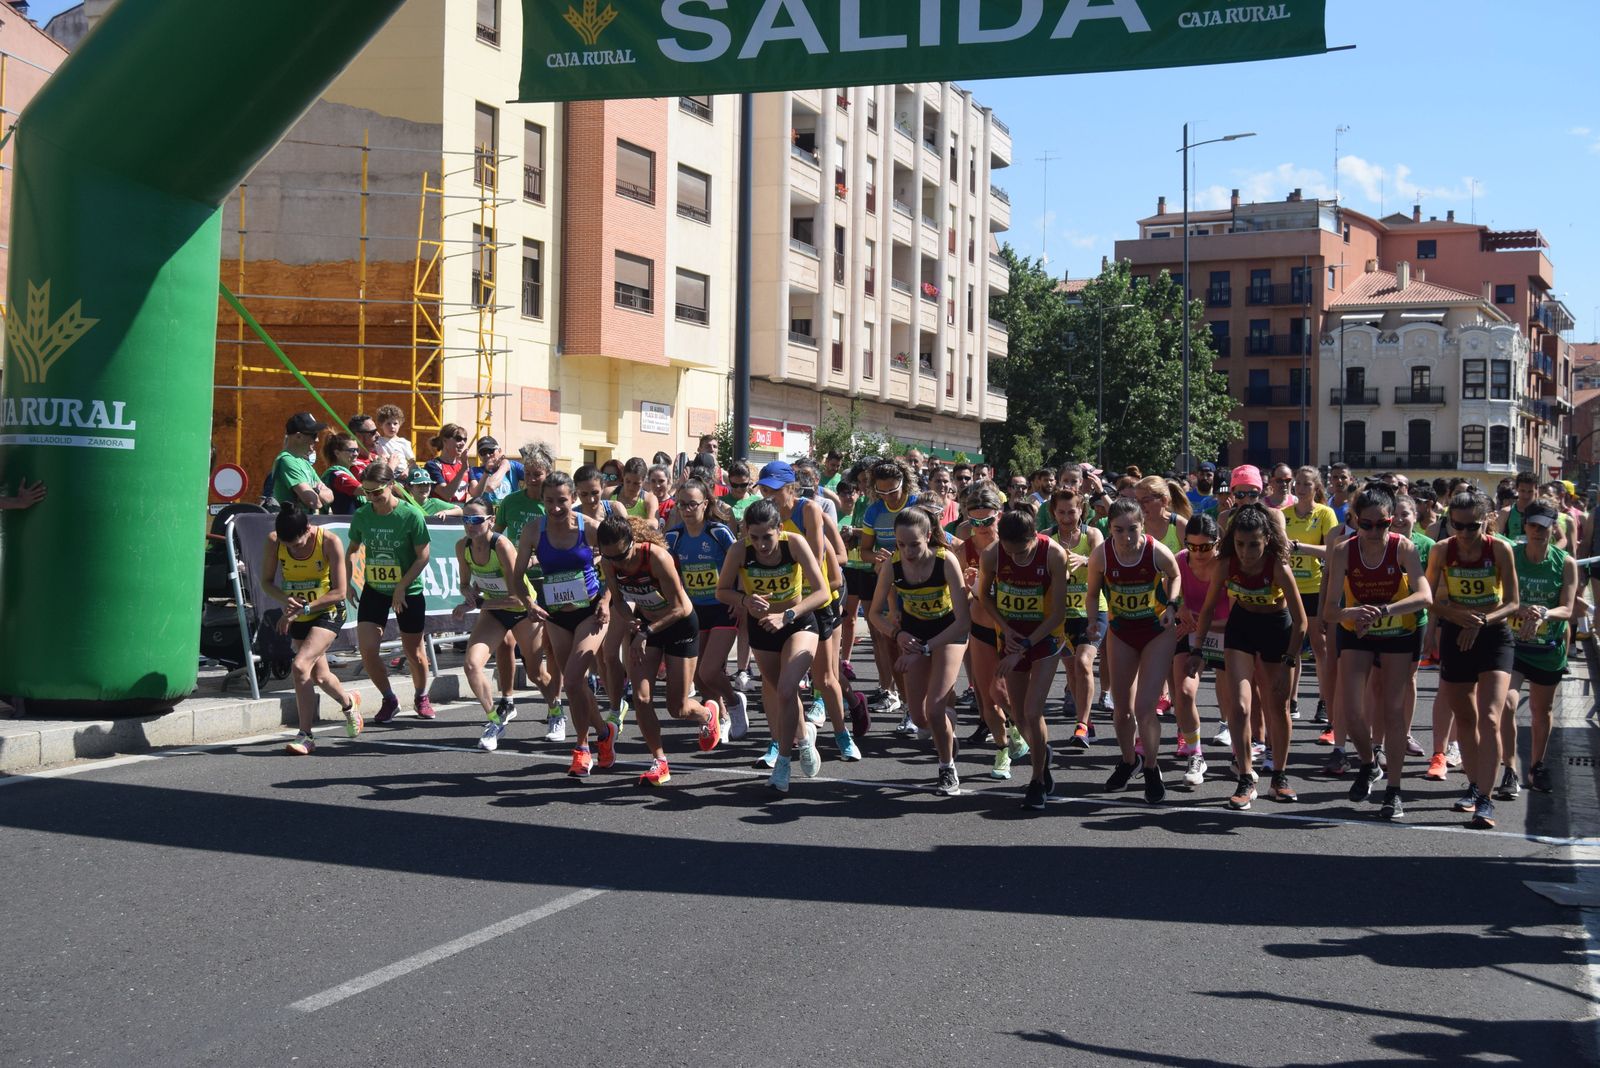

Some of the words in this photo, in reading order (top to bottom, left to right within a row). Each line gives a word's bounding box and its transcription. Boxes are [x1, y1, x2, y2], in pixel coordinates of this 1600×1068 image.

[1178, 10, 1223, 28] CAJA
[1224, 4, 1291, 24] RURAL
[656, 0, 1152, 63] SALIDA
[546, 51, 581, 68] CAJA
[581, 49, 636, 66] RURAL
[20, 397, 136, 431] RURAL
[28, 436, 73, 445] VALLADOLID
[88, 438, 124, 447] ZAMORA
[370, 567, 397, 581] 184
[686, 572, 717, 588] 242
[753, 576, 791, 592] 248
[1460, 579, 1485, 595] 39
[1000, 595, 1039, 611] 402
[1114, 593, 1151, 610] 404
